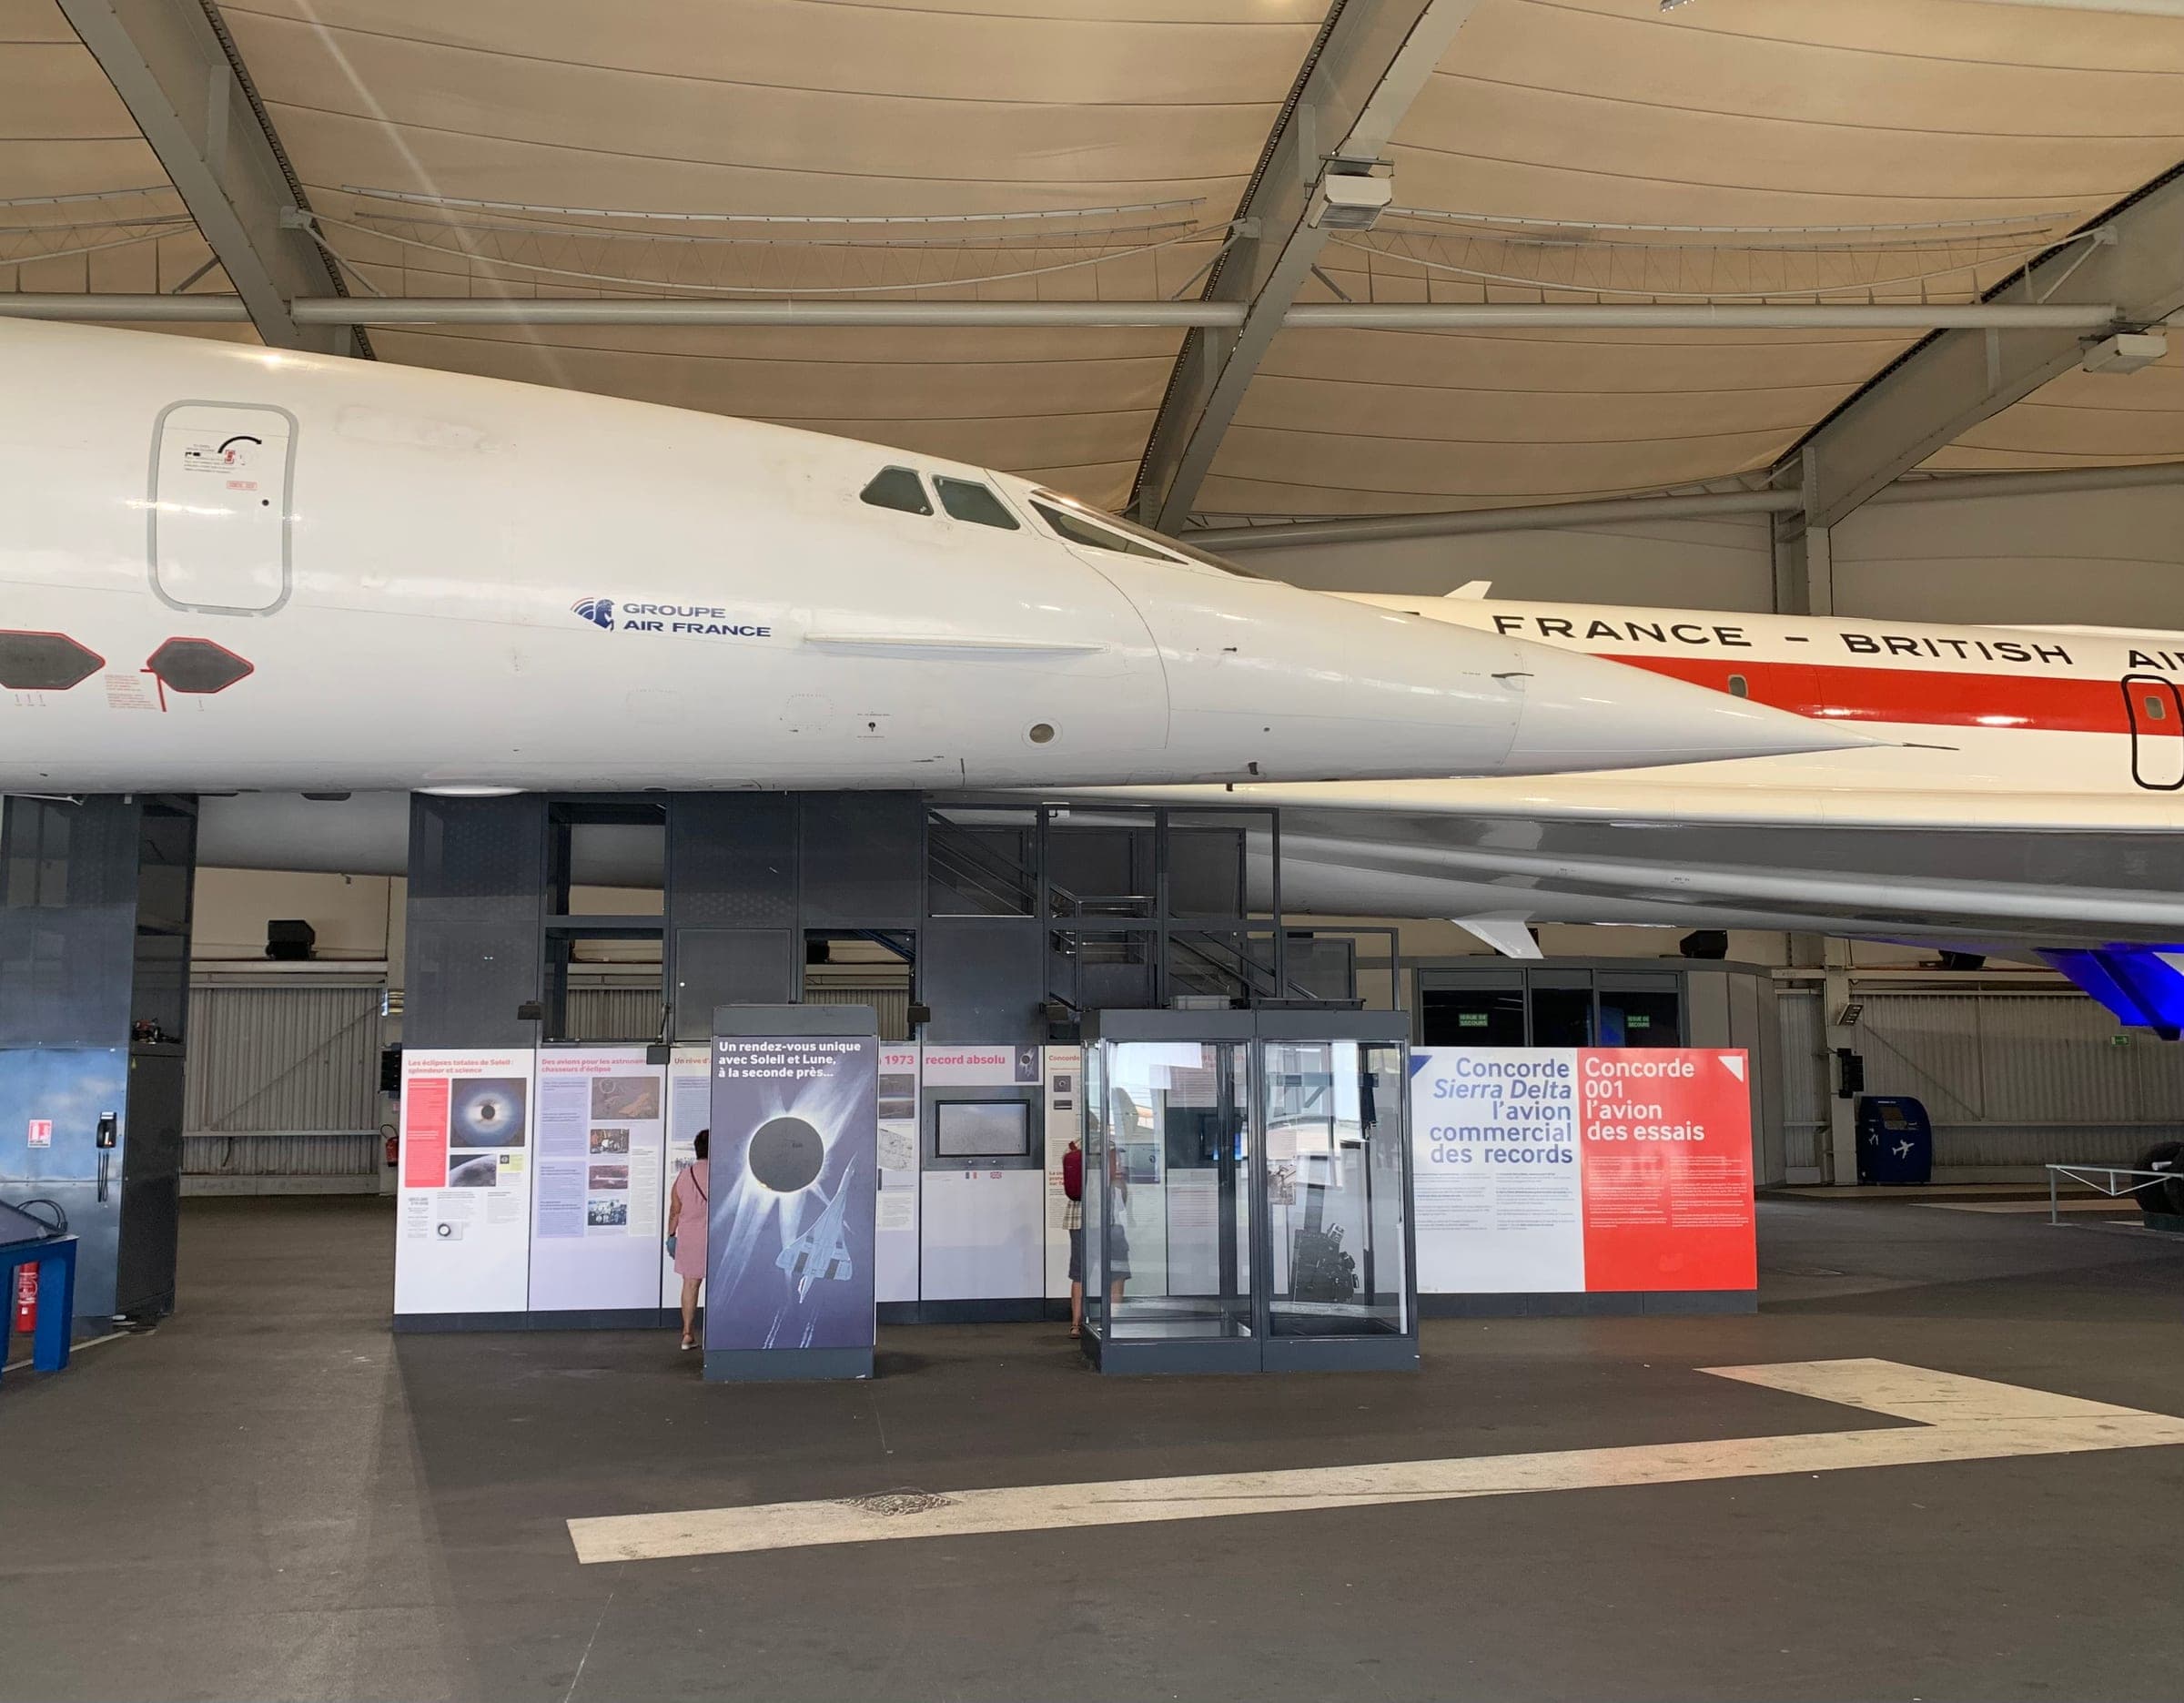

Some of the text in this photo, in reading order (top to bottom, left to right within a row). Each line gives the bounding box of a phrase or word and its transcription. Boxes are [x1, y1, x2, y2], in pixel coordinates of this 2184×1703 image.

[622, 603, 726, 619] GROUPE
[623, 620, 772, 637] AIR FRANCE
[1491, 615, 1752, 646] FRANCE
[1839, 633, 2074, 664] BRITISH
[719, 1040, 861, 1053] Un rendez-vous unique
[422, 1059, 452, 1068] éclipses
[718, 1054, 836, 1066] avec Soleil et Lune,
[885, 1055, 915, 1065] 1973
[925, 1054, 1006, 1065] record absolu
[1456, 1057, 1570, 1078] Concorde
[1584, 1057, 1695, 1078] Concorde
[718, 1067, 834, 1080] à la seconde près...
[1433, 1079, 1572, 1099] Sierra Delta
[1584, 1080, 1623, 1099] 001
[1492, 1100, 1572, 1120] l'avion
[1586, 1100, 1663, 1120] l'avion
[1430, 1122, 1572, 1141] commercial
[1587, 1120, 1705, 1140] des essais
[1431, 1143, 1573, 1163] des records
